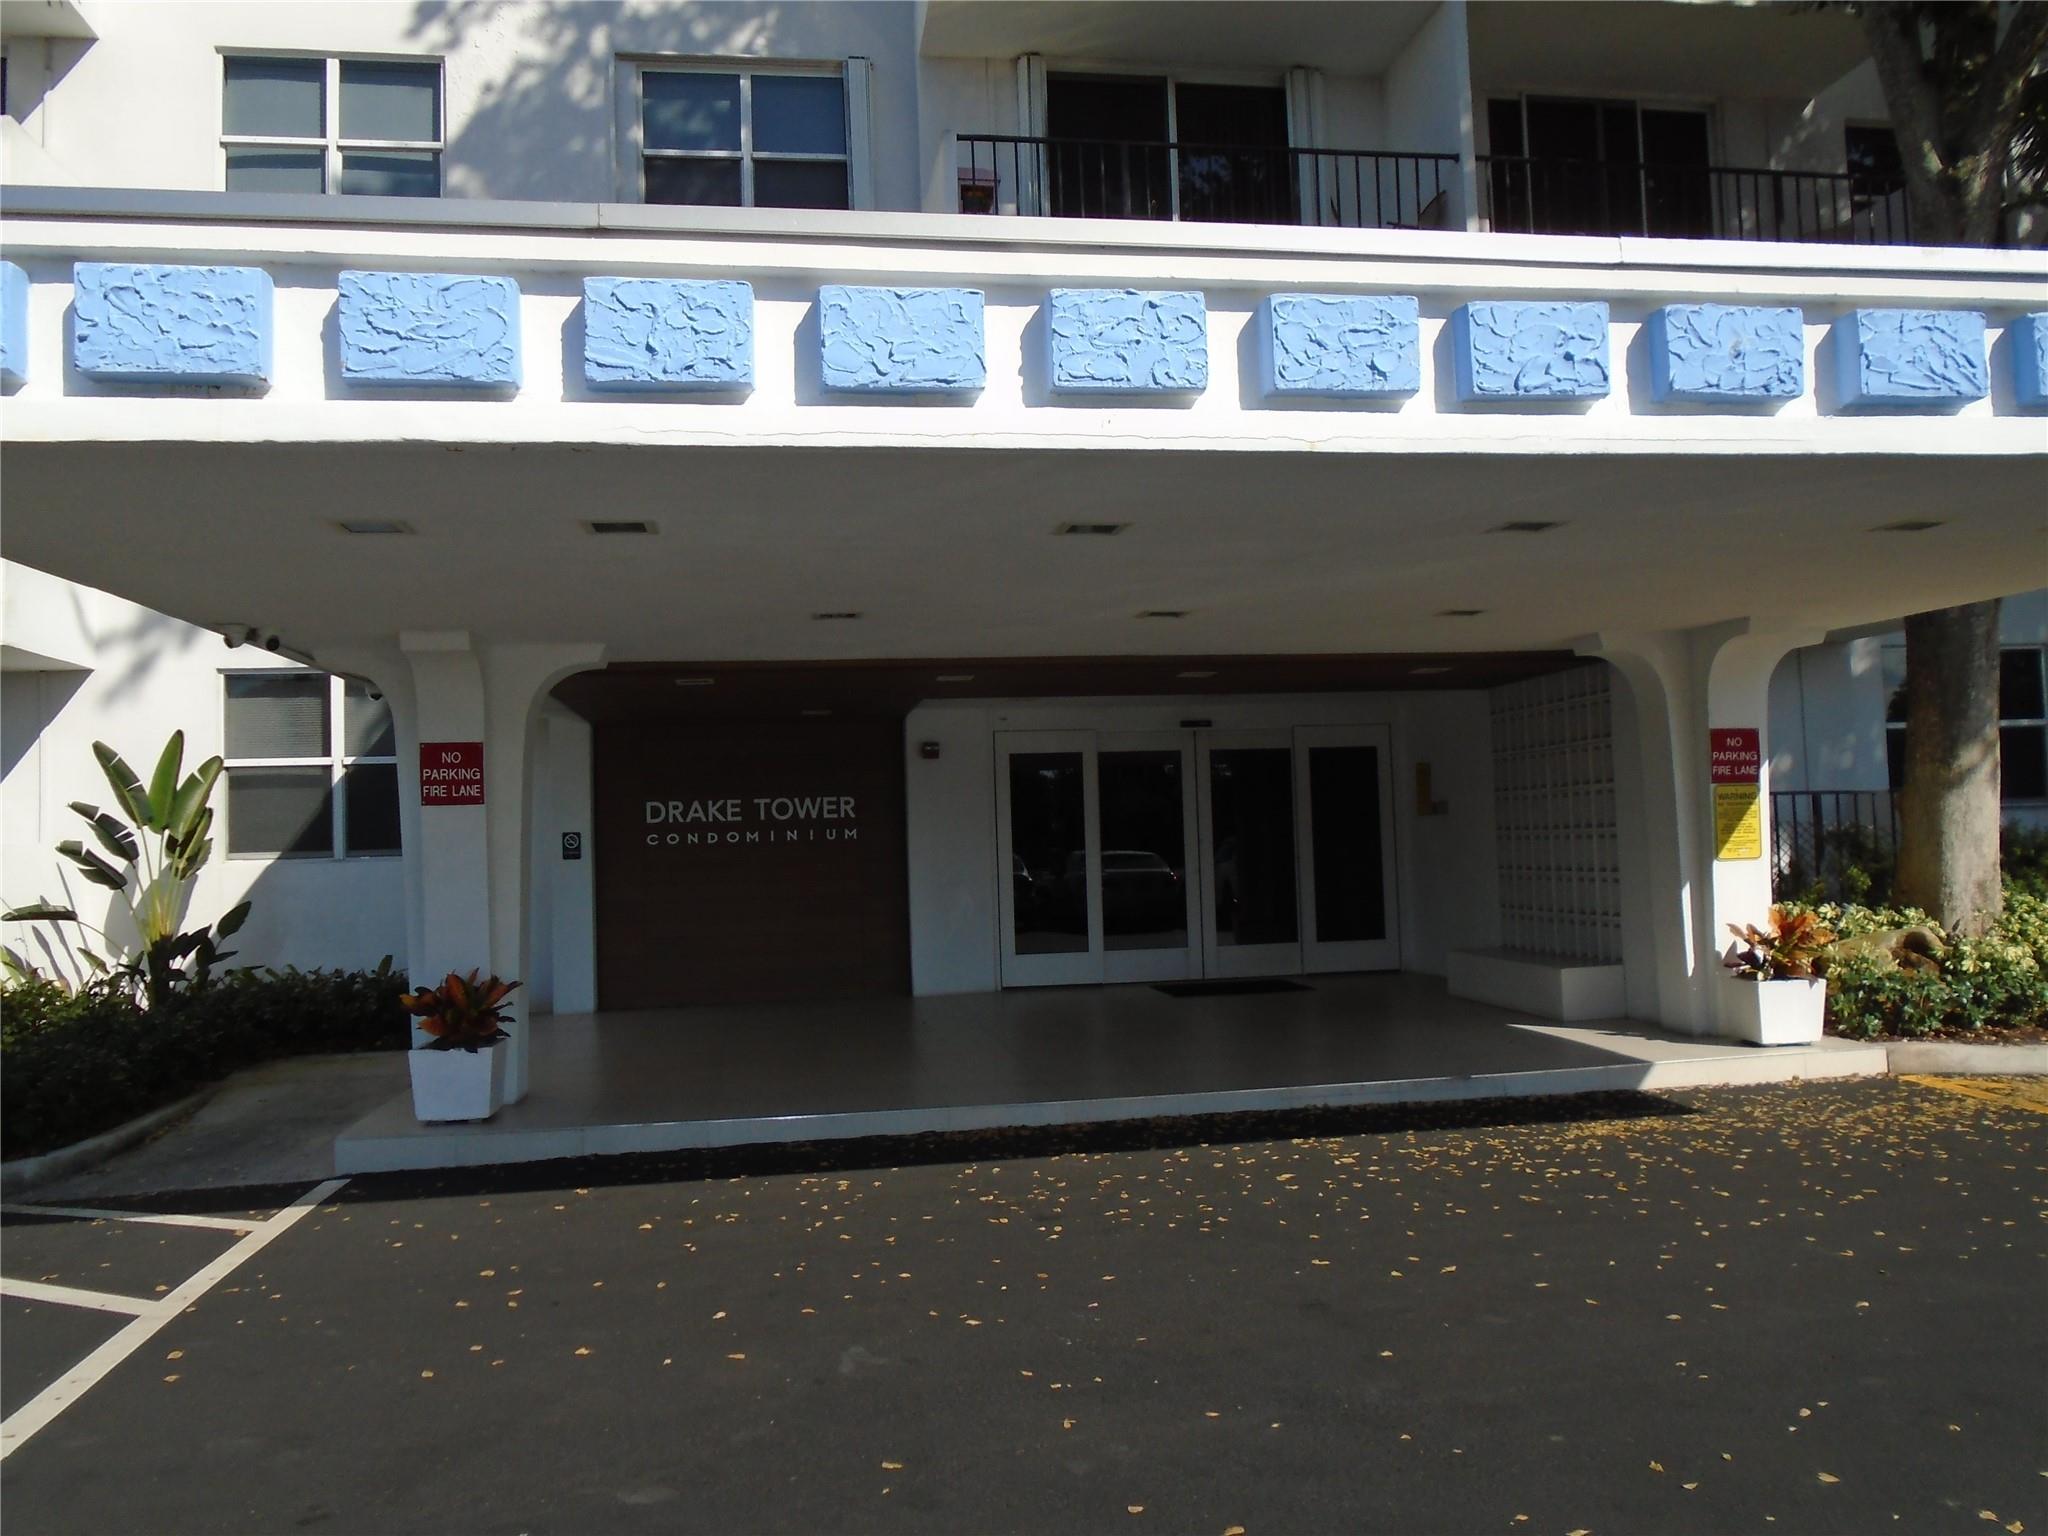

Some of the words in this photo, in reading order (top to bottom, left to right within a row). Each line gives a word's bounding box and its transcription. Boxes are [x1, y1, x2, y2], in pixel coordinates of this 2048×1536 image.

[1726, 737, 1743, 747] NO
[441, 751, 462, 764] NO
[1712, 751, 1758, 761] PARKING
[422, 768, 481, 780] PARKING
[1712, 765, 1732, 775] FIRE
[1734, 765, 1758, 775] LANE
[423, 785, 447, 797] FIRE
[452, 784, 481, 797] LANE
[645, 799, 743, 824] DRAKE
[753, 796, 856, 820] TOWER
[646, 828, 858, 846] CONDOMINIUM
